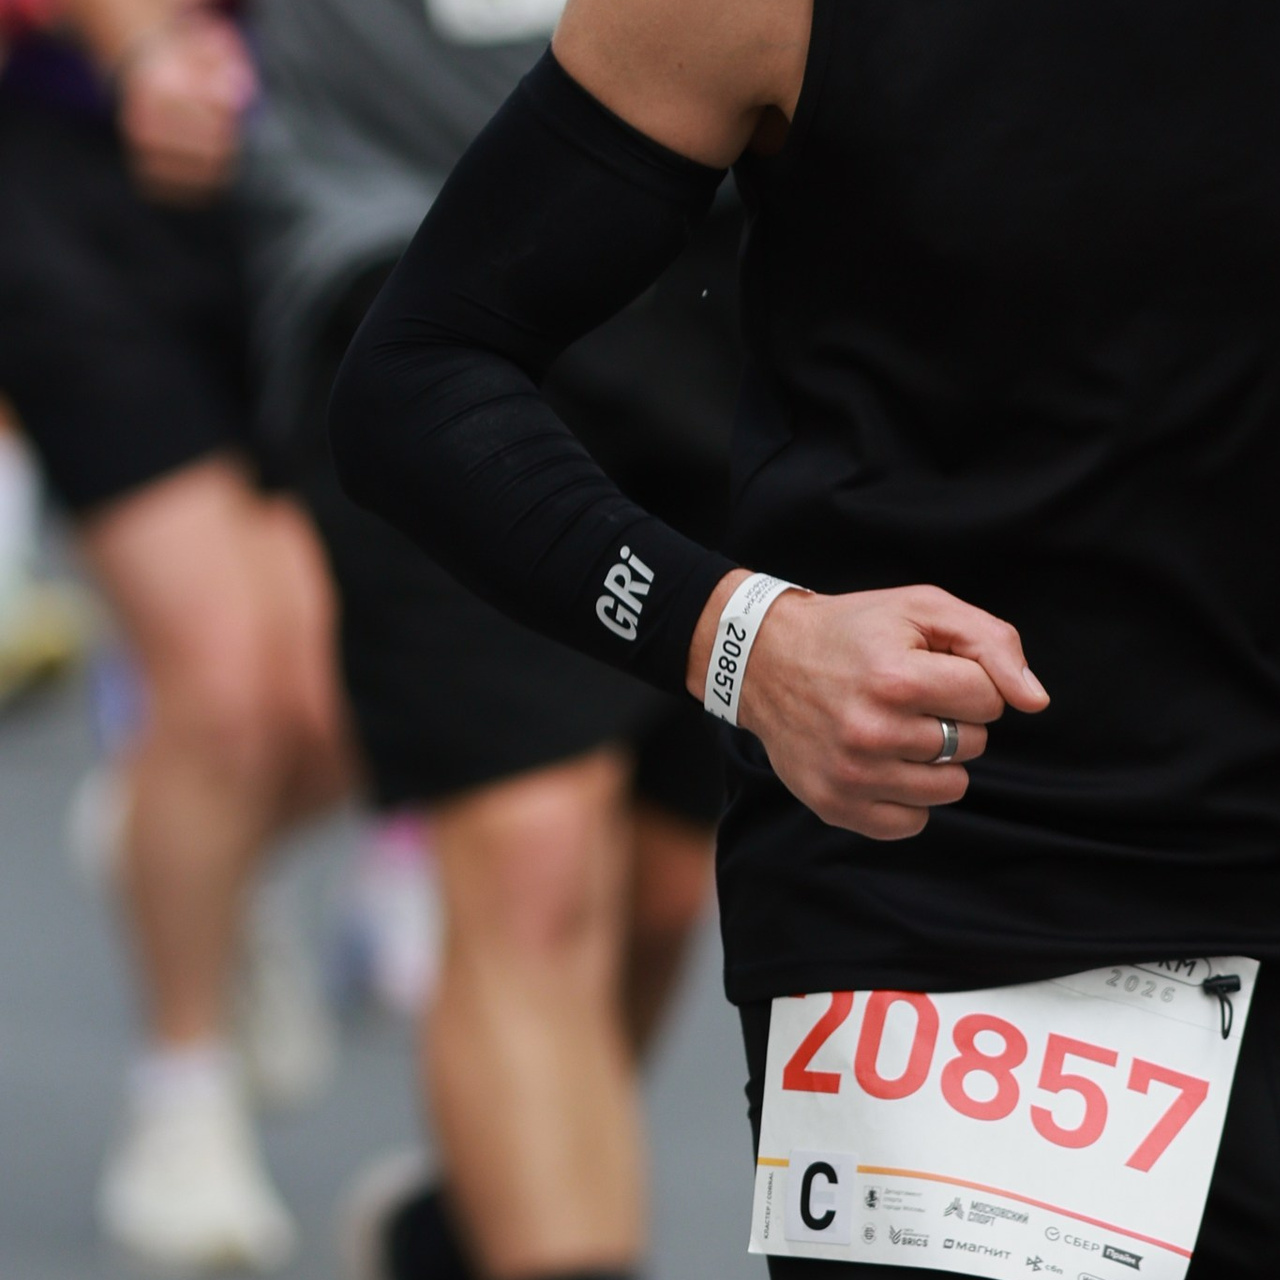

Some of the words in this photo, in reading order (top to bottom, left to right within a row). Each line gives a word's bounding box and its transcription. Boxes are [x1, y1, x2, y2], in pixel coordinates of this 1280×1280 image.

[713, 622, 746, 707] 20857
[782, 990, 1210, 1173] 20857
[800, 1161, 838, 1231] C
[1063, 1234, 1101, 1251] СБЕР
